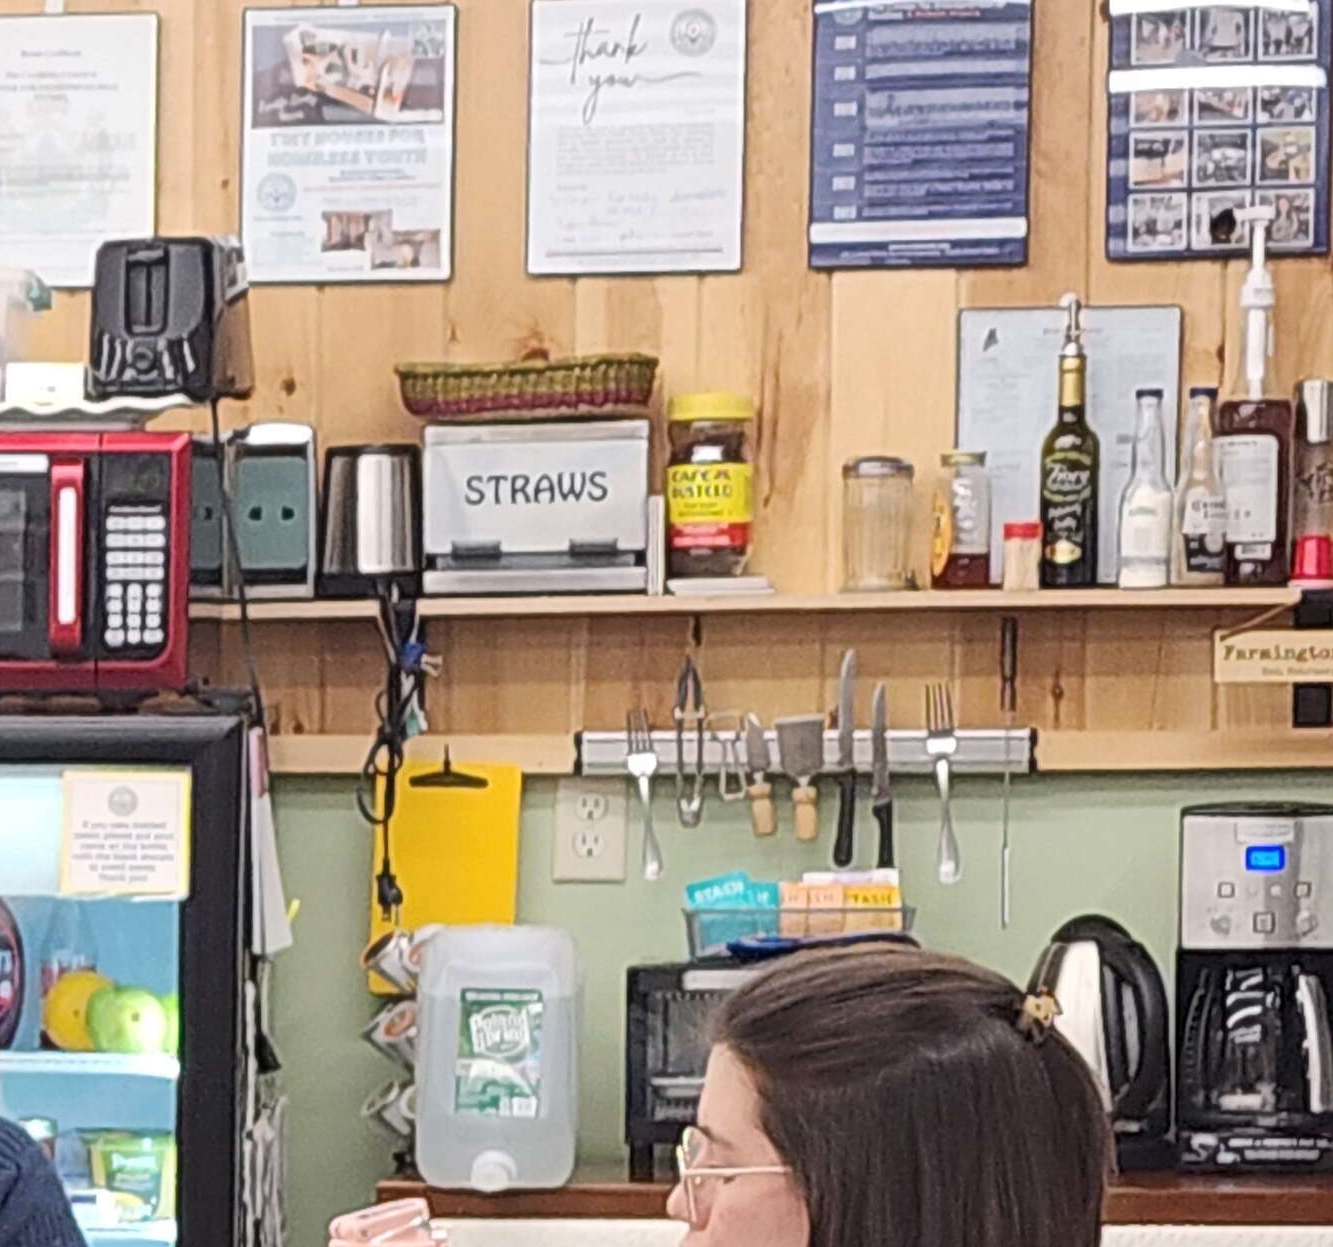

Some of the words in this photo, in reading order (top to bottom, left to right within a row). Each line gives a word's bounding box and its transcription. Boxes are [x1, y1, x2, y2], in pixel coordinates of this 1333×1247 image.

[539, 13, 648, 84] thank
[465, 471, 609, 506] STRAWS
[1223, 644, 1333, 662] Farmingto
[693, 879, 745, 904] STASH
